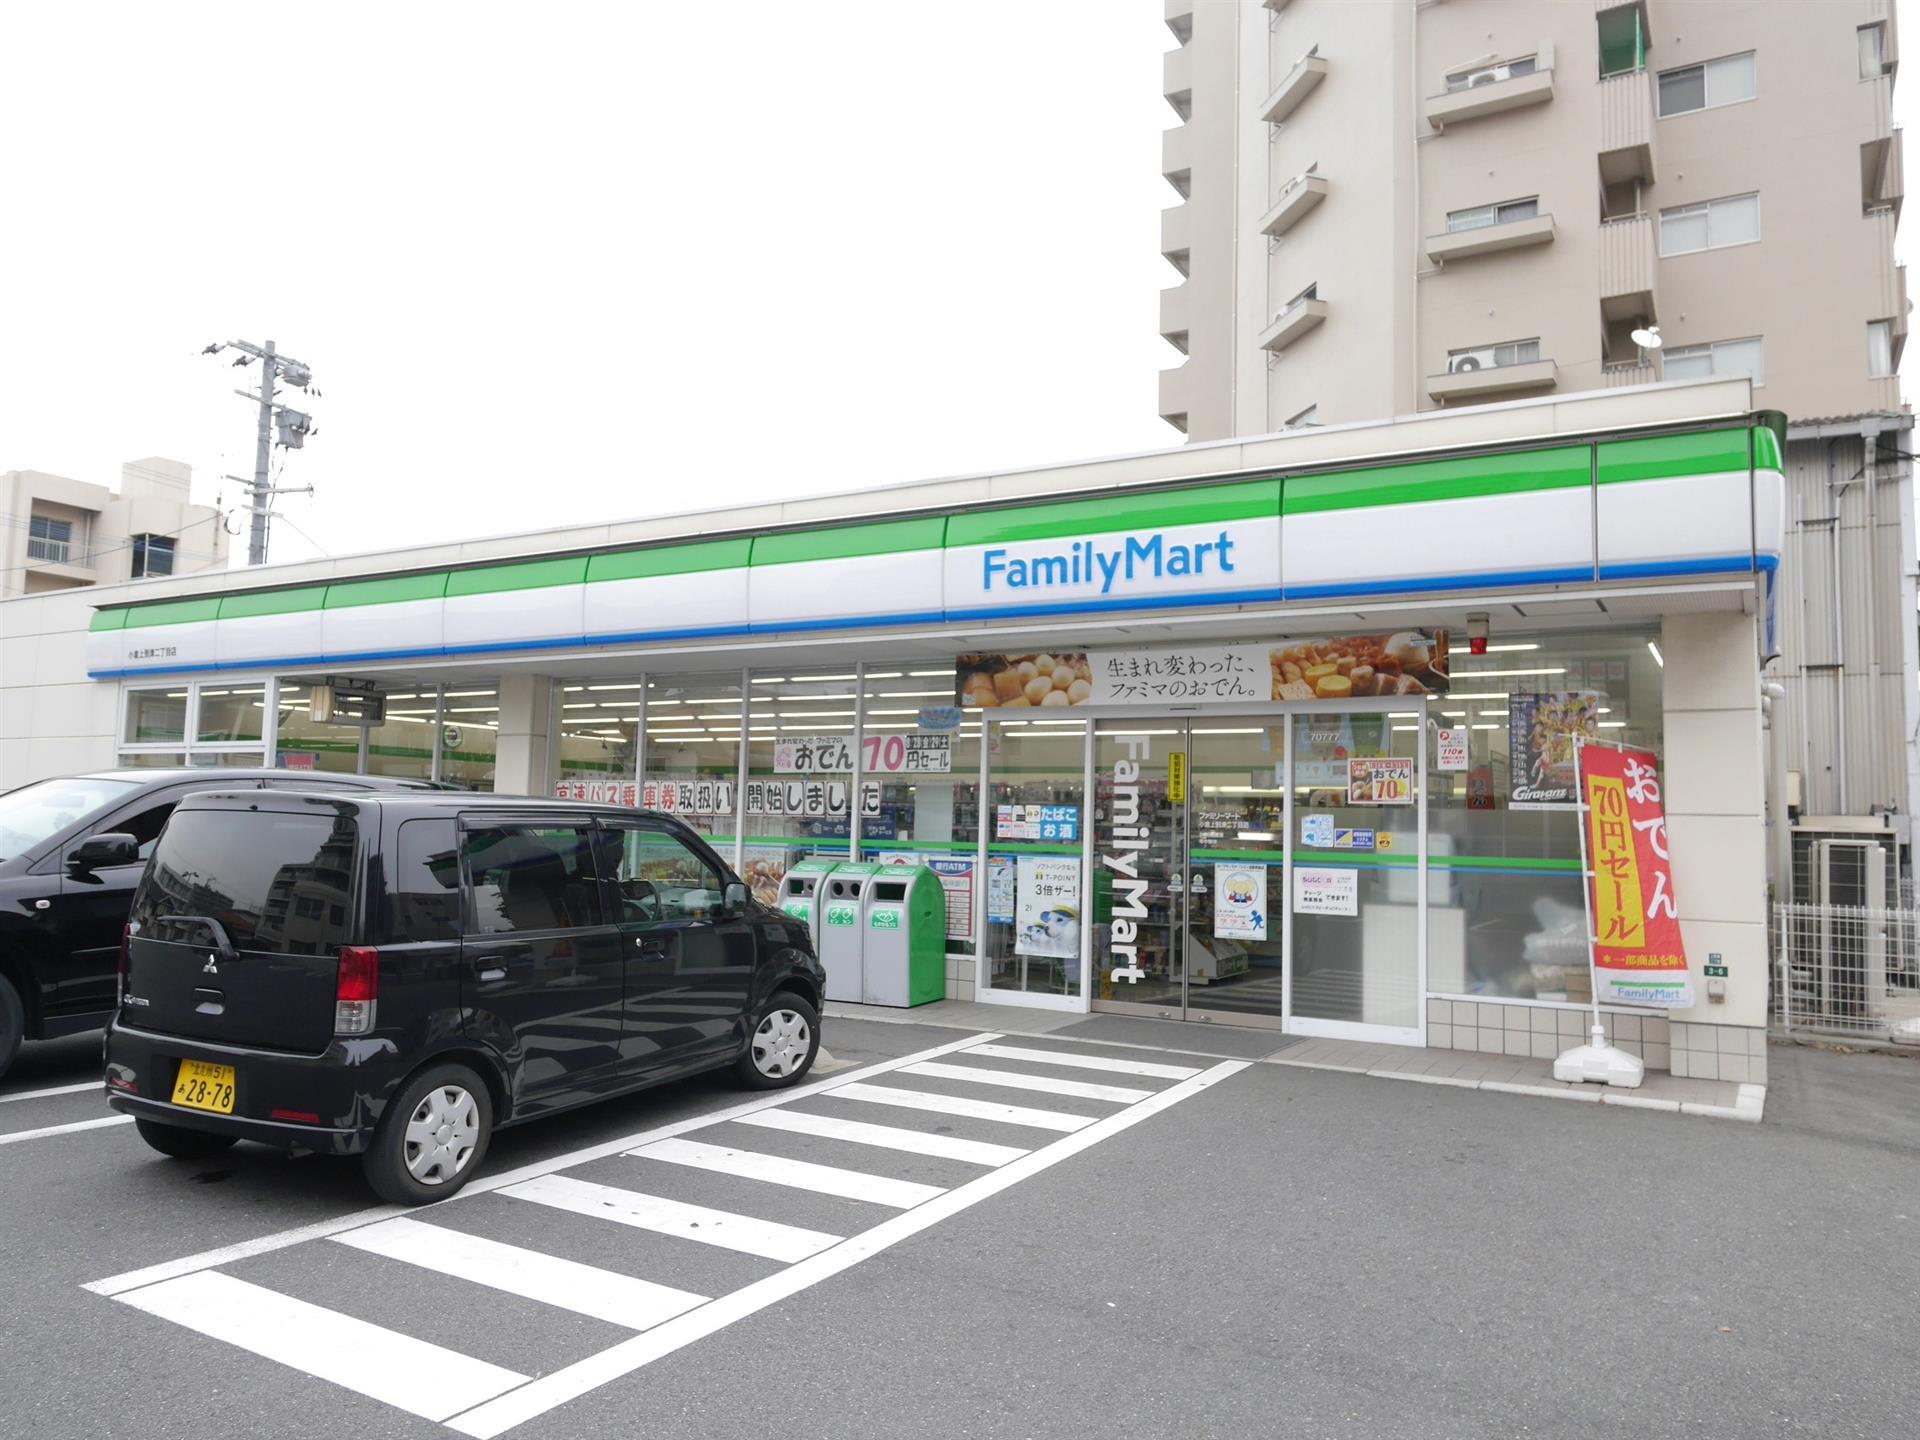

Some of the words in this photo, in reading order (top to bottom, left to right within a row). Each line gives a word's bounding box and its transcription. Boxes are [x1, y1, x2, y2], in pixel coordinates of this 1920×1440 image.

[983, 530, 1235, 593] FamilyMart
[1107, 653, 1255, 678] 生まれ変わった、
[1109, 676, 1256, 698] ファミマのおでん。
[795, 744, 854, 769] おでん
[863, 736, 904, 771] 70
[906, 751, 949, 768] 円セール
[1373, 769, 1408, 779] おでん
[1376, 780, 1398, 799] 70
[1041, 807, 1077, 821] たばこ
[1043, 823, 1073, 839] お酒
[1623, 757, 1679, 920] おでん
[1102, 735, 1151, 984] FamilyMart
[1593, 784, 1639, 941] 70円セール
[1617, 988, 1680, 999] FamilyMart
[185, 1078, 232, 1108] 28-78
